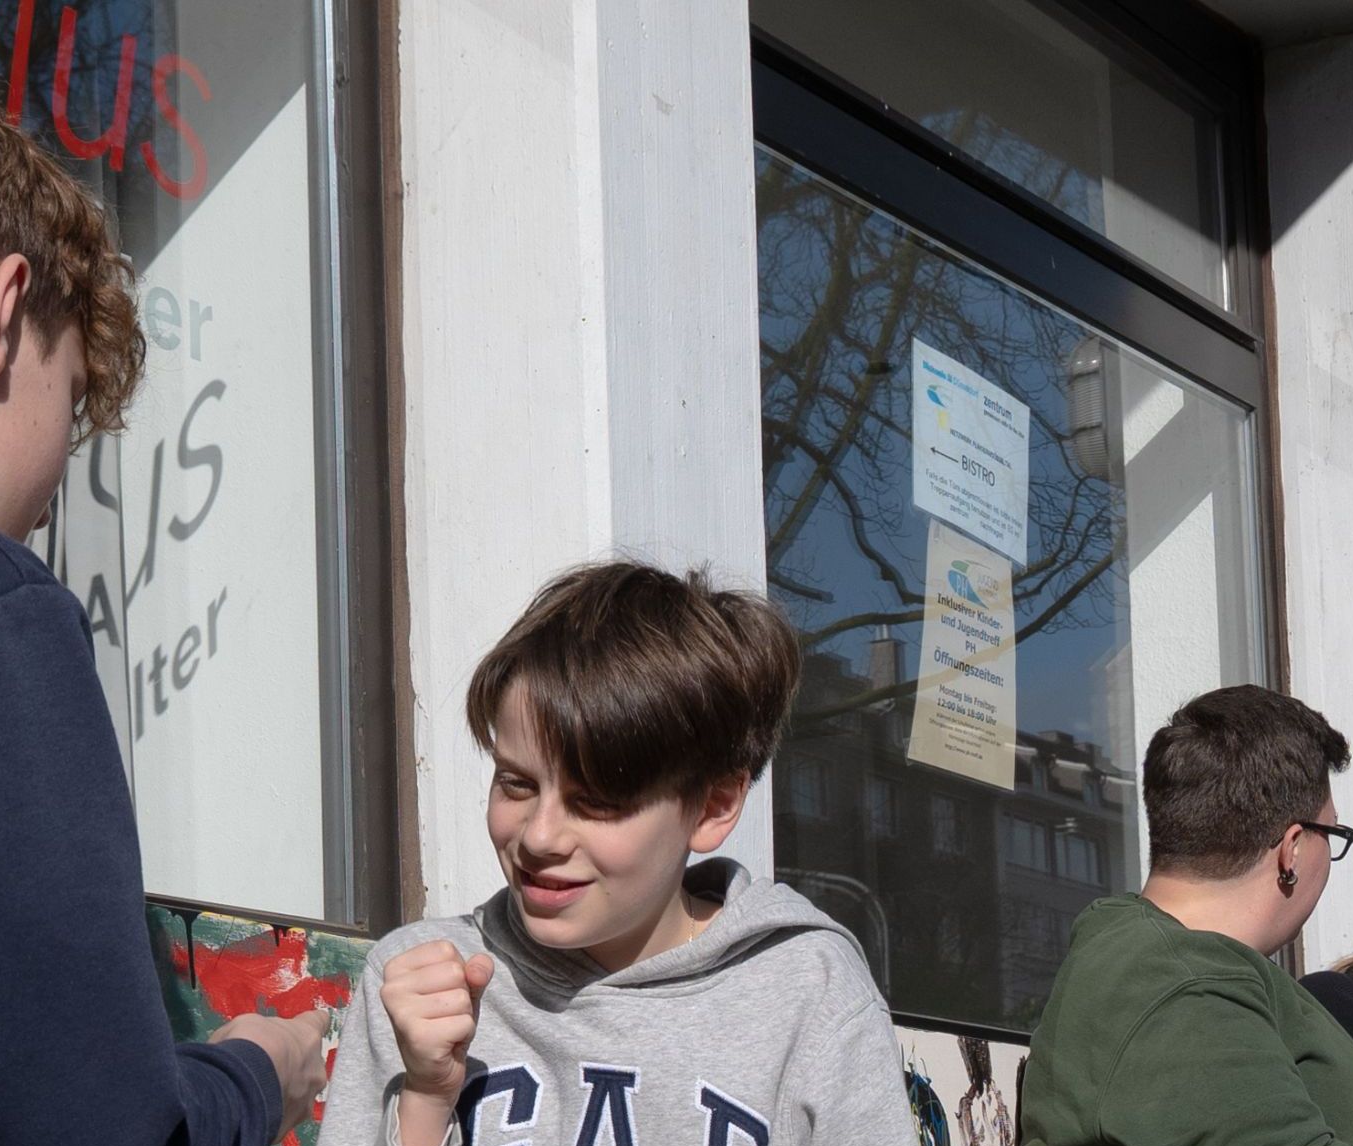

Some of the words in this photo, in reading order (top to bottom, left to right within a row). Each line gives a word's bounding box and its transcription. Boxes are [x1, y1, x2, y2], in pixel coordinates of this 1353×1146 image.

[144, 286, 213, 362] er
[961, 454, 996, 487] BISTRO
[955, 573, 969, 601] PH
[937, 593, 976, 619] Inklusiver
[977, 610, 1004, 632] Kinder-
[941, 614, 956, 629] und
[957, 619, 1001, 648] Jugendtreff
[965, 640, 977, 655] PH
[933, 645, 1004, 688] Öffnungszeiten:
